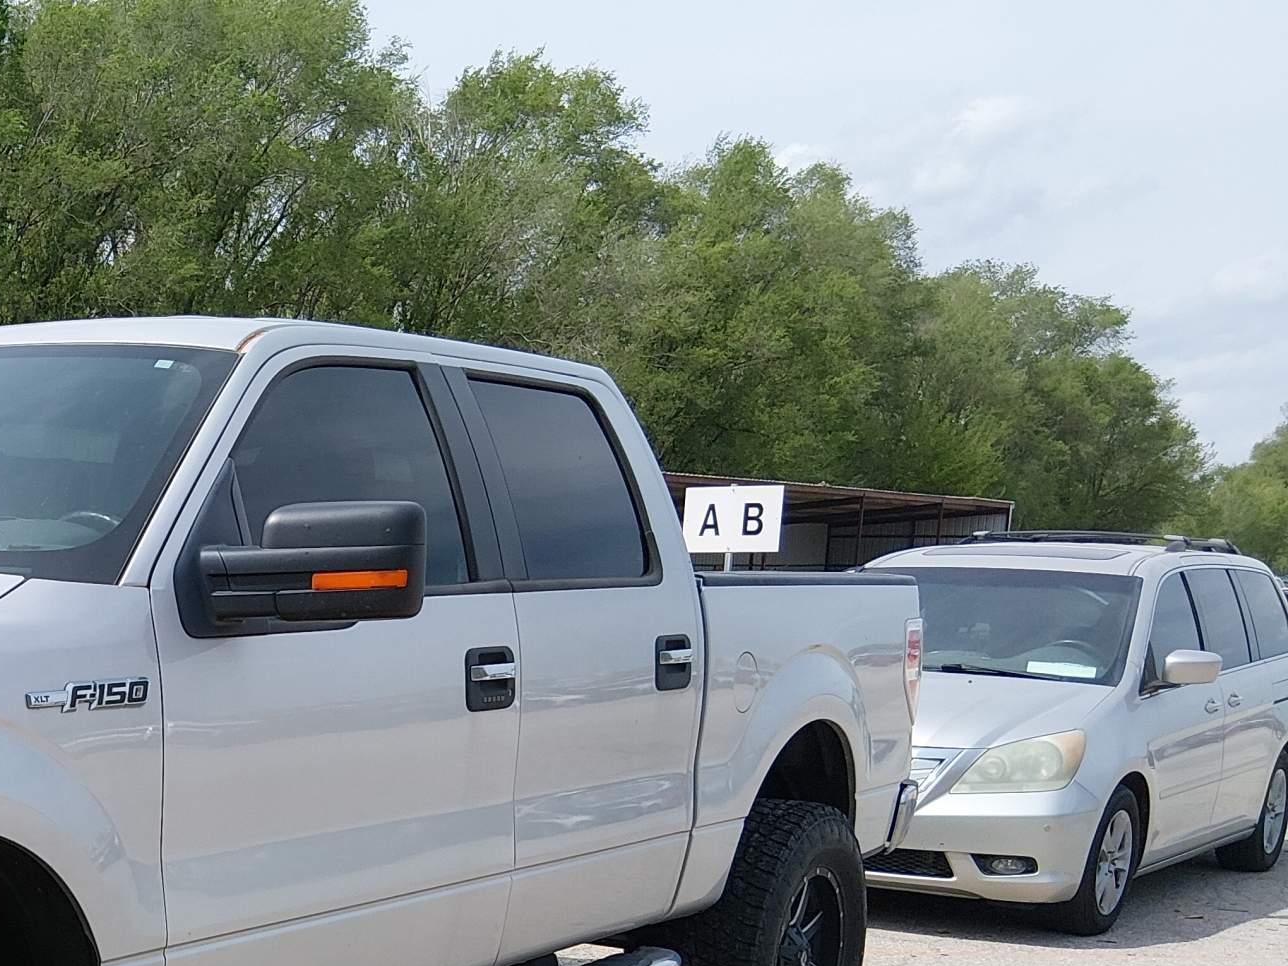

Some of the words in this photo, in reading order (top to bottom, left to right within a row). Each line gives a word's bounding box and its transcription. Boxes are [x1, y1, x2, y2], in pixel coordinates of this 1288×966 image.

[698, 503, 720, 536] A
[741, 502, 764, 536] B
[33, 695, 50, 703] XLT
[69, 680, 150, 708] F-150
